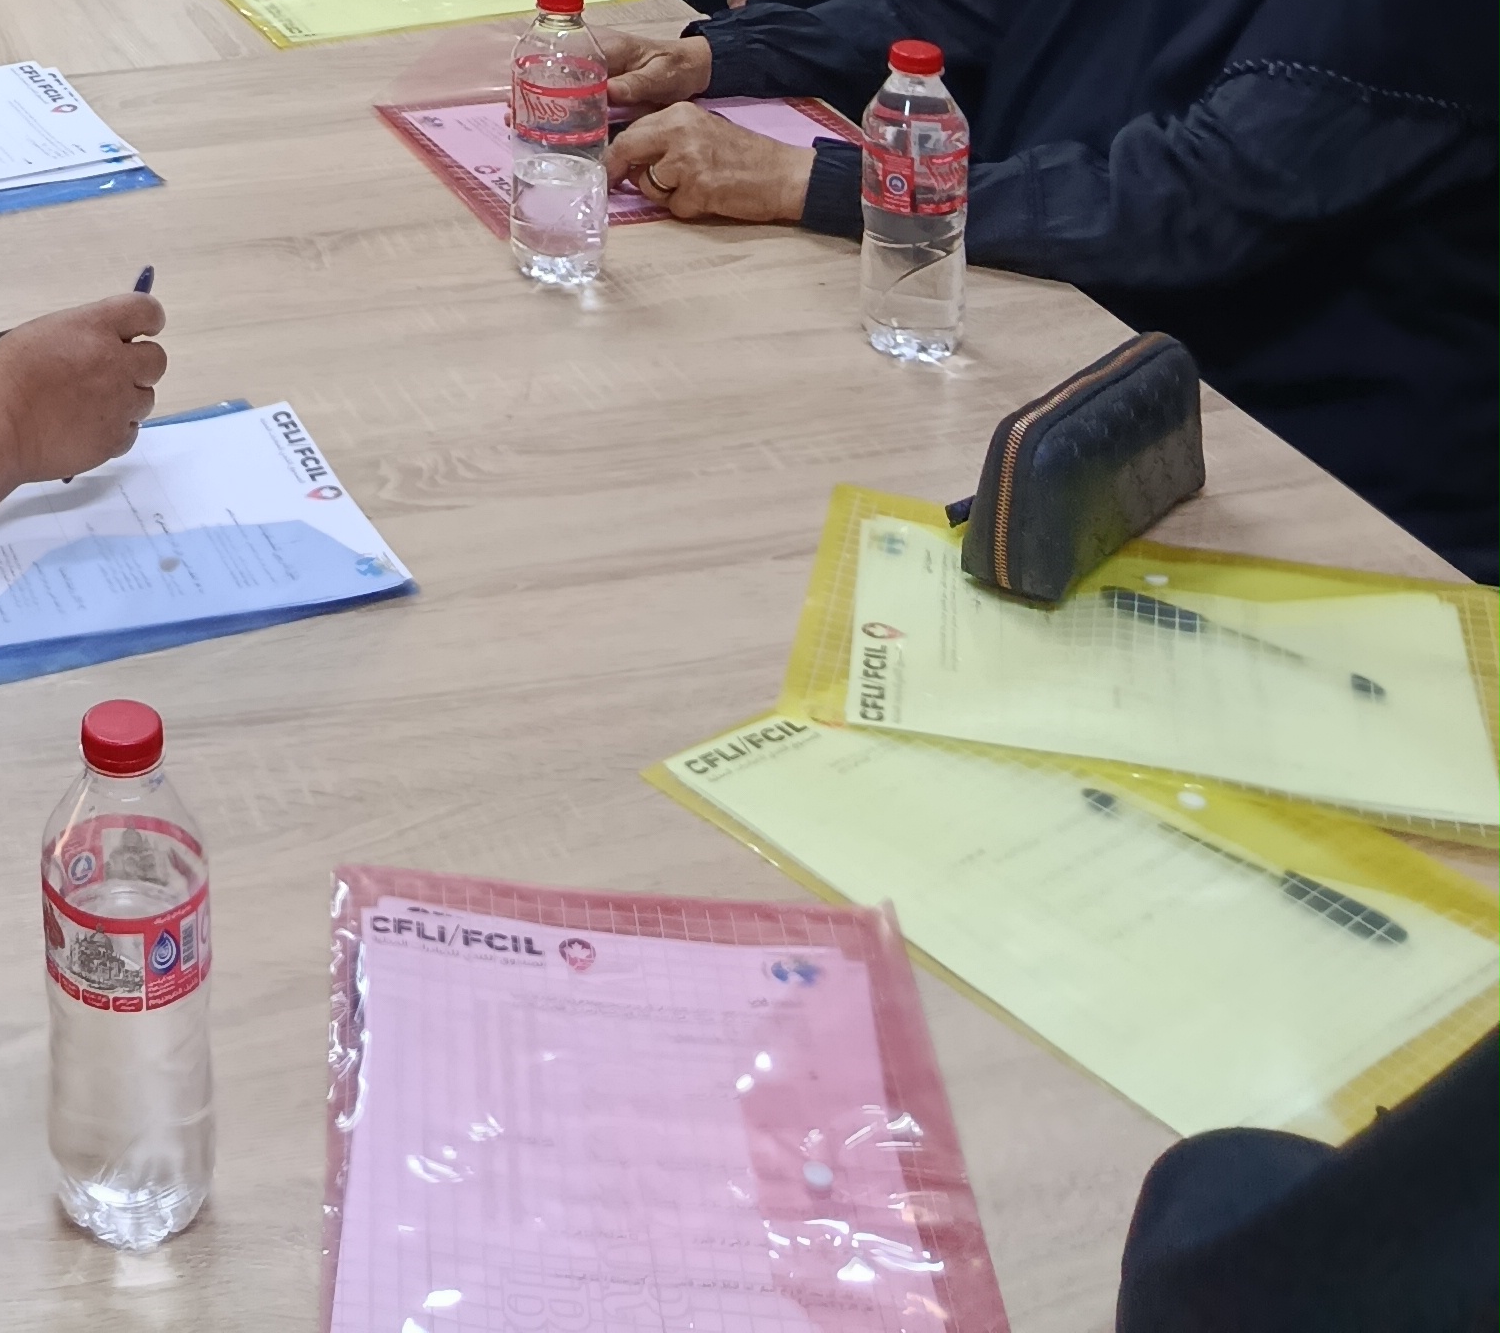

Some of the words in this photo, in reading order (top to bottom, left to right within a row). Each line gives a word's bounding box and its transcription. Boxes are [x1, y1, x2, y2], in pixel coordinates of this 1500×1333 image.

[19, 64, 64, 103] CFLIFCIL
[272, 411, 328, 482] CFLI/FCIL
[858, 644, 888, 722] CFLI/FCIL
[684, 719, 808, 775] CFLI/FCIL
[370, 915, 546, 956] CFLI/FCIL
